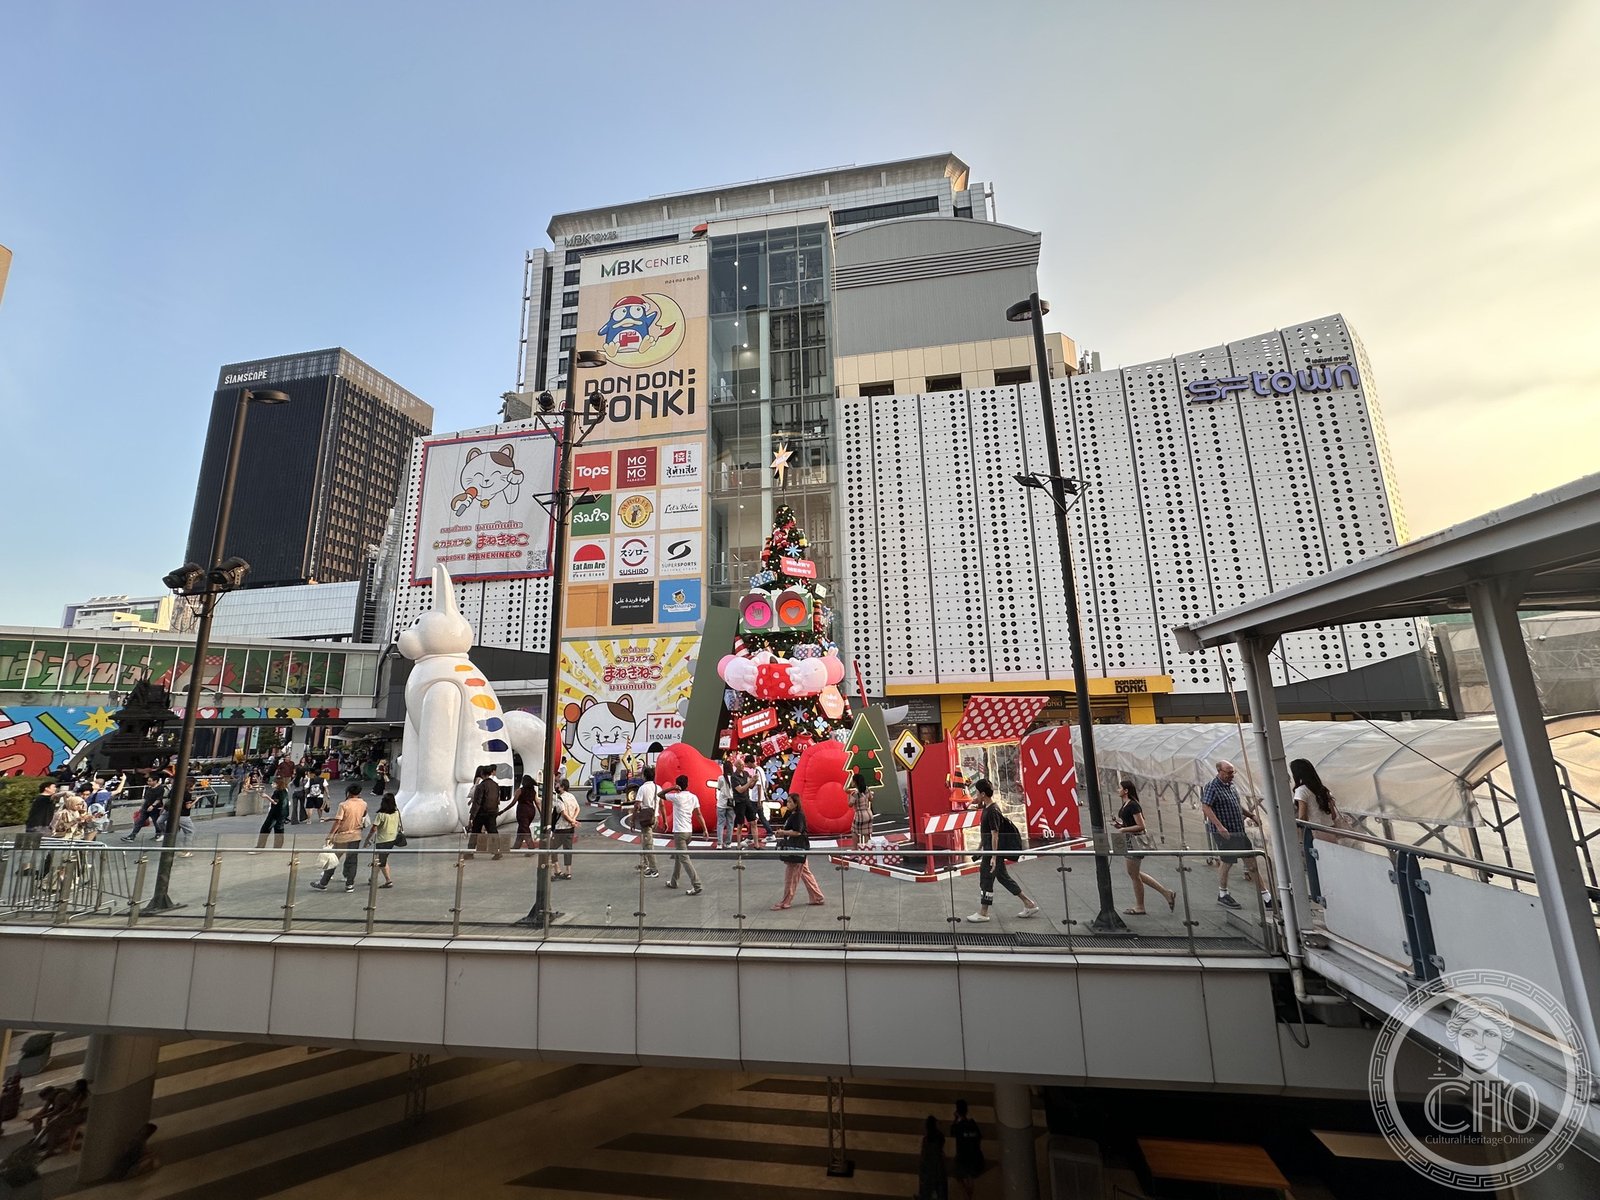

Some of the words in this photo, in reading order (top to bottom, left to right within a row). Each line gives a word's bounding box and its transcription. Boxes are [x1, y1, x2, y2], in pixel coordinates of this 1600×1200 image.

[565, 233, 591, 247] MBK
[601, 257, 643, 278] MBK
[645, 254, 689, 269] CENTER
[224, 370, 268, 385] SIAMSCAPE
[584, 376, 631, 397] DON
[636, 369, 683, 391] DON
[628, 456, 647, 466] MO
[576, 466, 609, 479] Tops
[627, 468, 647, 479] MO
[573, 508, 610, 523] สมใจ
[476, 533, 530, 550] まねきねこ
[620, 549, 649, 557] スシロー
[583, 562, 593, 570] Am
[594, 561, 605, 569] Are
[619, 568, 649, 576] SUSHIRO
[603, 664, 663, 683] まねきねこ
[1116, 684, 1147, 693] DONKI
[654, 718, 662, 728] 7
